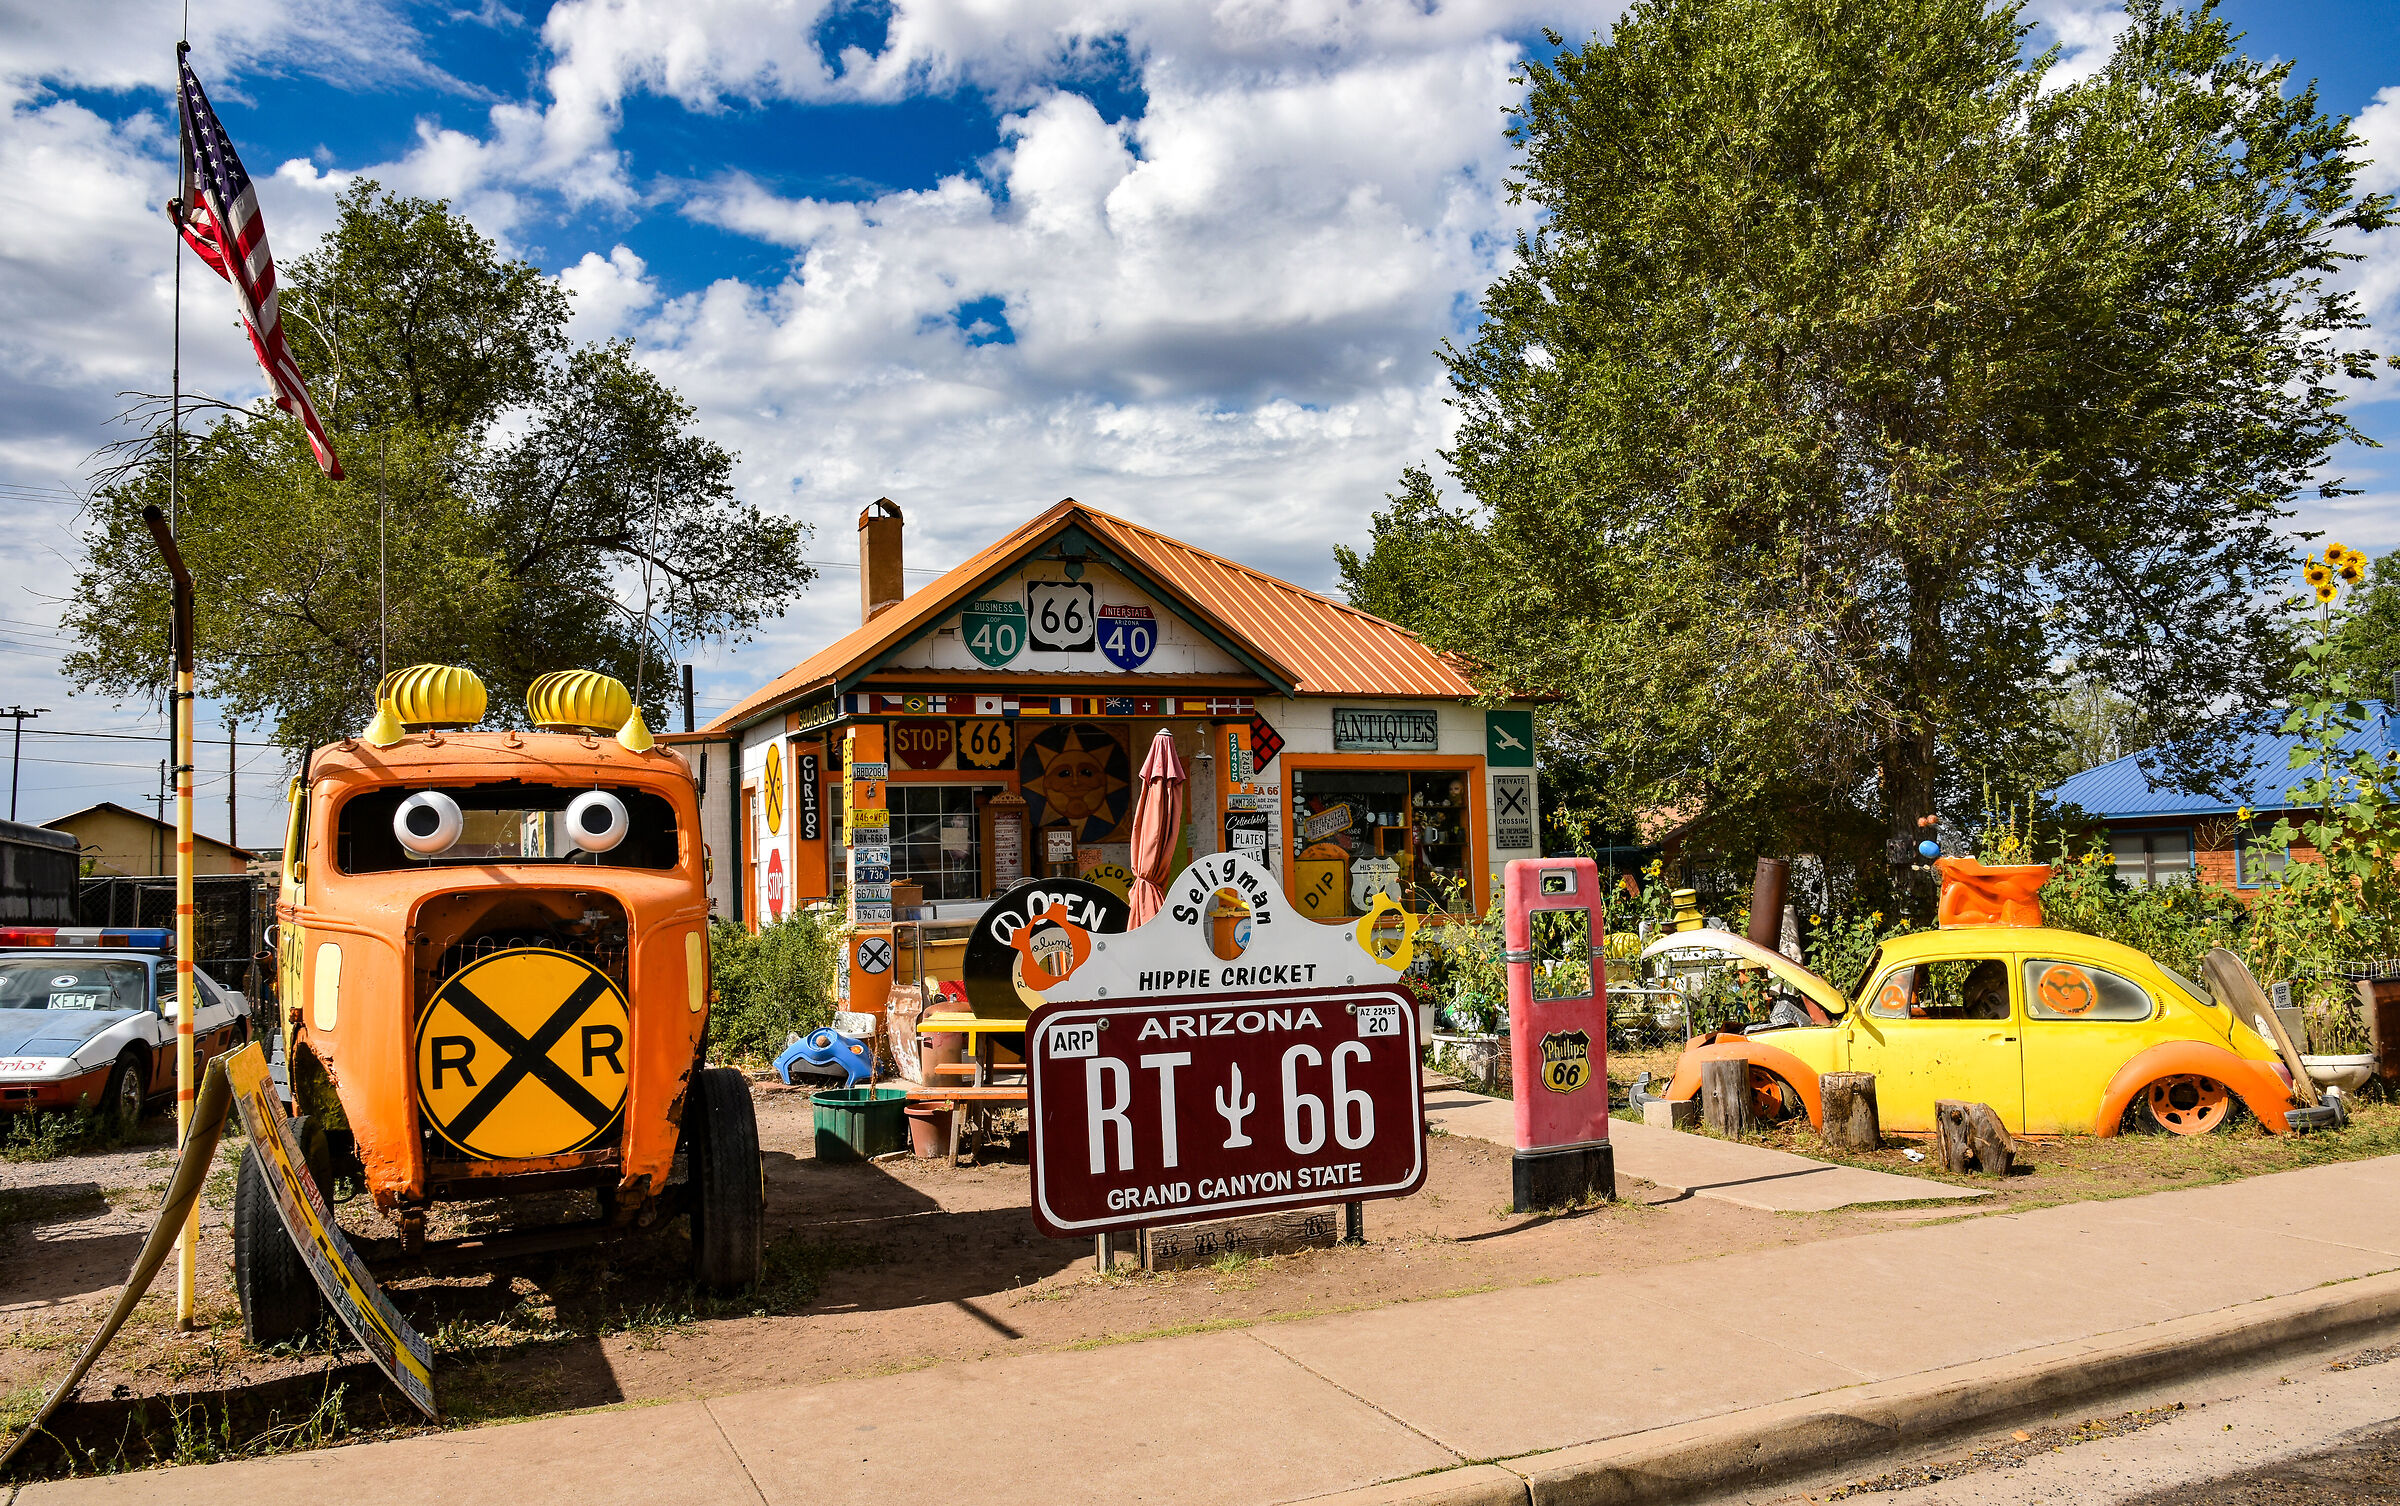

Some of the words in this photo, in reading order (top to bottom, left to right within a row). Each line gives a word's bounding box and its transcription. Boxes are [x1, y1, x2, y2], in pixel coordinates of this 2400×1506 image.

[974, 602, 1013, 612] BUSINESS
[1041, 598, 1084, 633] 66
[1105, 607, 1148, 617] INTERSTATE
[971, 624, 1017, 656] 40
[1105, 627, 1149, 657] 40
[799, 700, 835, 730] SOUVENIRS
[898, 728, 949, 750] STOP
[971, 722, 1000, 754] 66
[1338, 714, 1436, 749] ANTIQUES
[803, 756, 816, 838] CURIOS
[1267, 787, 1278, 795] 66
[1522, 797, 1528, 805] R
[1235, 834, 1264, 845] PLATES
[768, 872, 783, 899] STOP
[1172, 858, 1271, 927] Seligman
[1304, 872, 1333, 909] DIP
[1027, 890, 1107, 932] OPEN
[884, 951, 890, 959] R
[1139, 969, 1210, 991] HIPPIE
[1221, 964, 1317, 987] CRICKET
[50, 995, 95, 1010] KEEP
[1137, 1008, 1322, 1041] ARIZONA
[1369, 1017, 1389, 1033] 20
[1053, 1029, 1095, 1052] ARP
[1546, 1040, 1586, 1061] Phillips
[431, 1036, 477, 1089] R
[582, 1024, 624, 1076] R
[1552, 1064, 1580, 1086] 66
[1085, 1052, 1192, 1175] RT
[1282, 1042, 1375, 1155] 66
[1107, 1182, 1190, 1210] GRAND
[1199, 1171, 1294, 1202] CANYON
[1298, 1163, 1362, 1188] STATE
